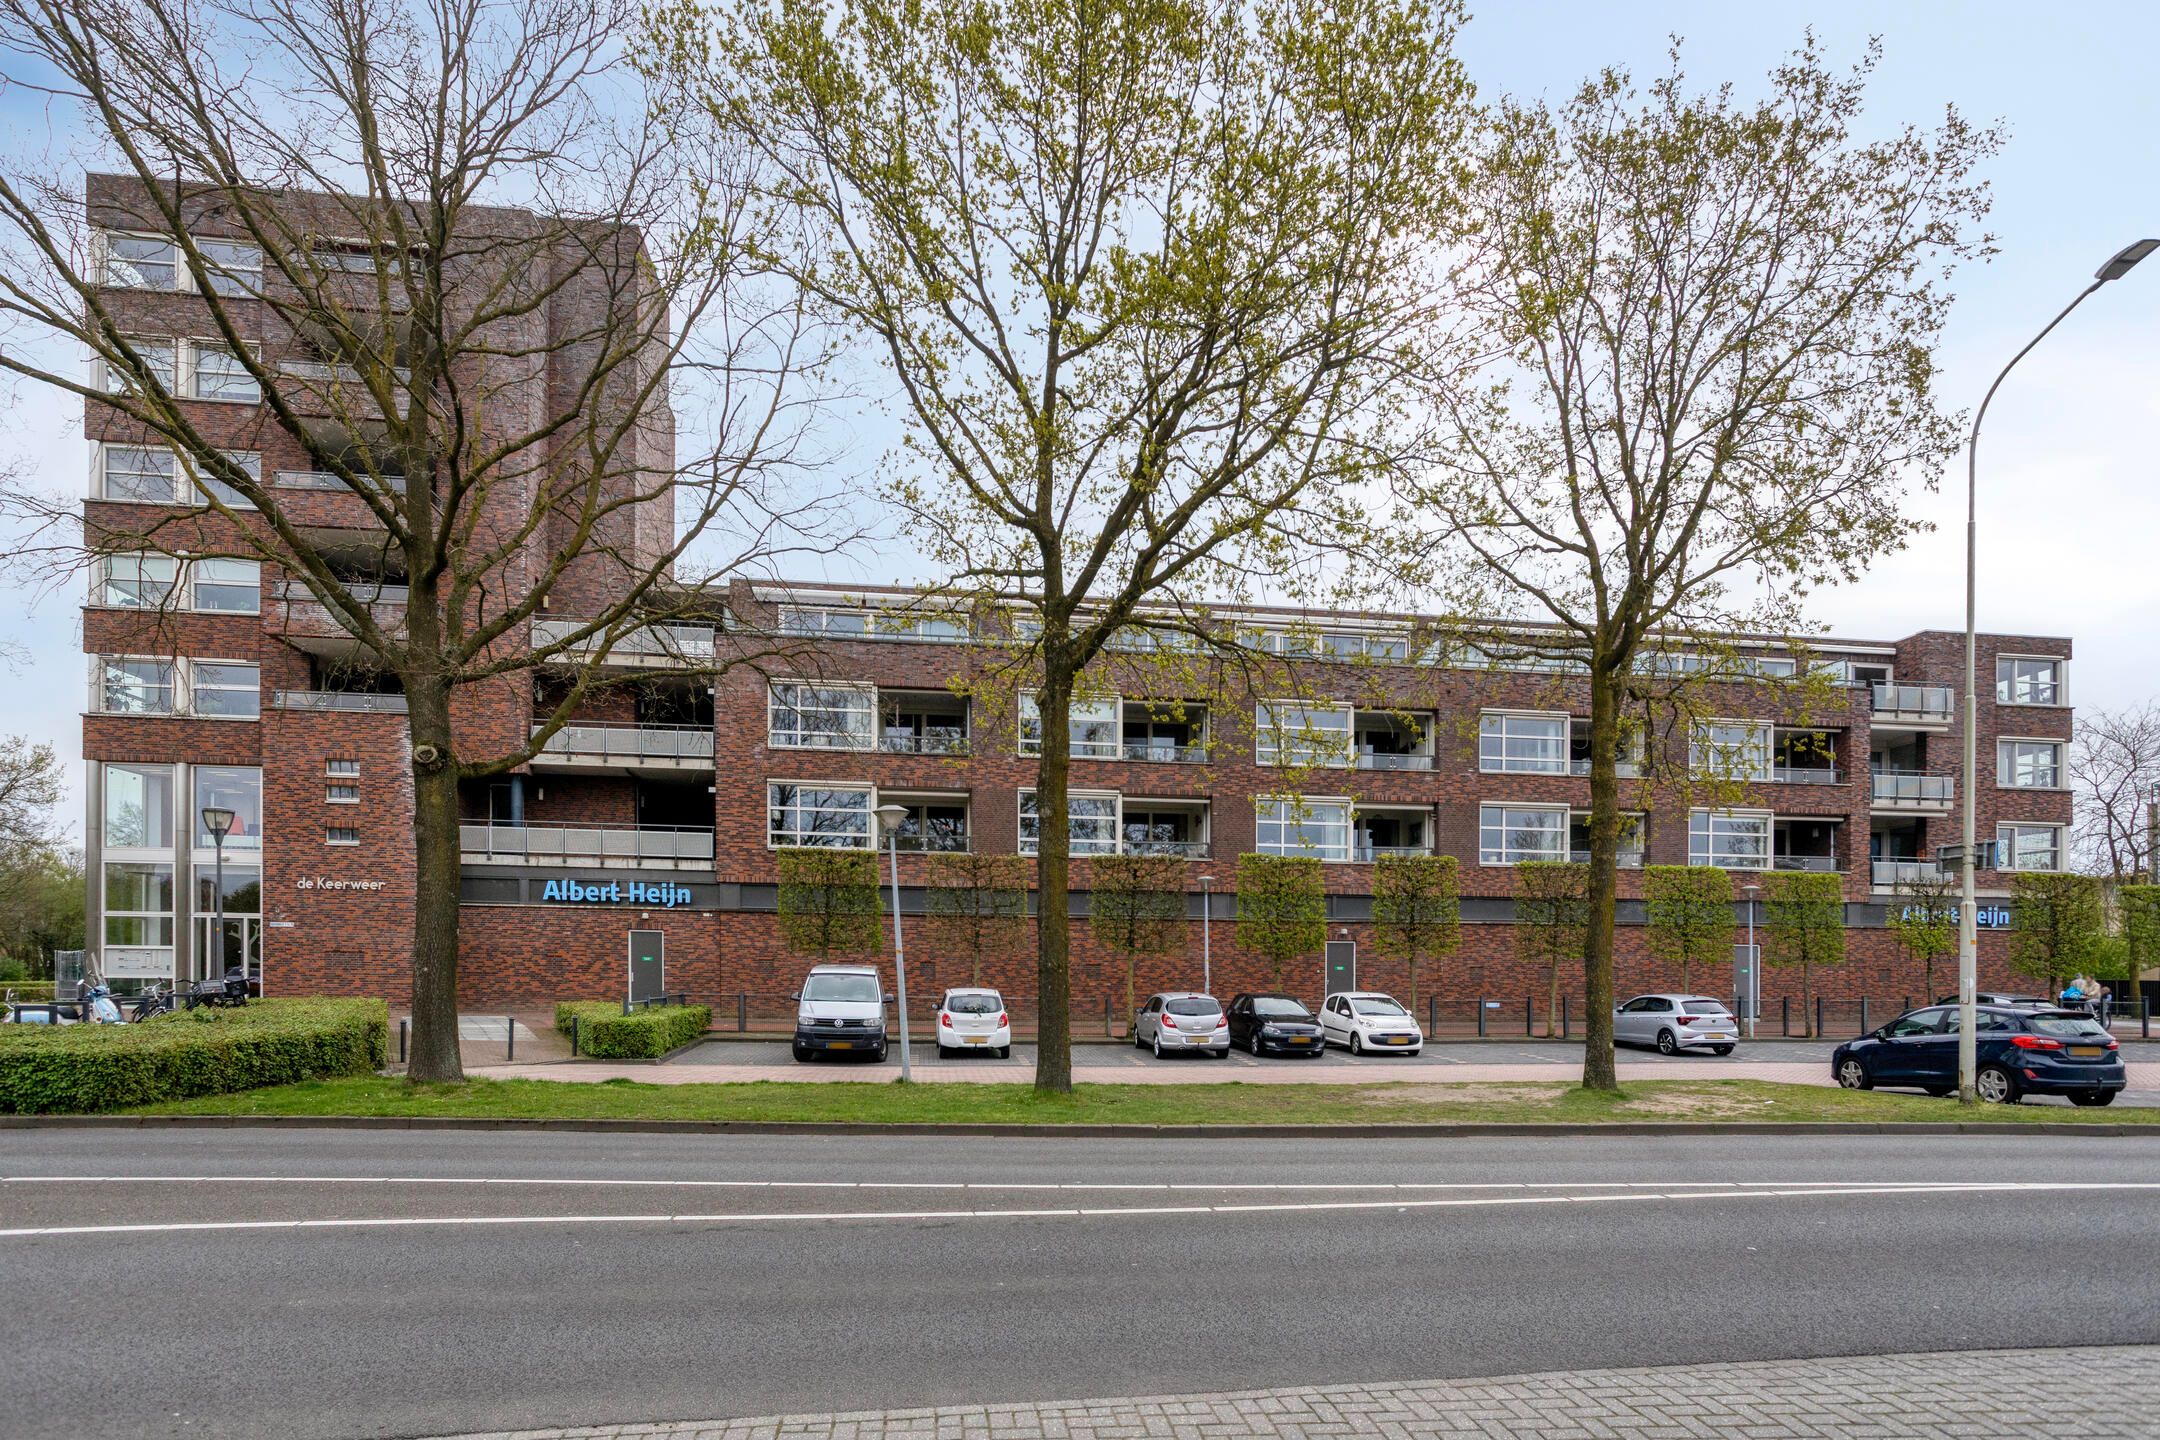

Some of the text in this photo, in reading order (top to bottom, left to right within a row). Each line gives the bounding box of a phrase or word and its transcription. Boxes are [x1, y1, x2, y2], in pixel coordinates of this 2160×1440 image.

[297, 876, 386, 890] de Keerweer
[543, 879, 691, 908] Albert Heijn
[1976, 906, 2009, 927] eijn
